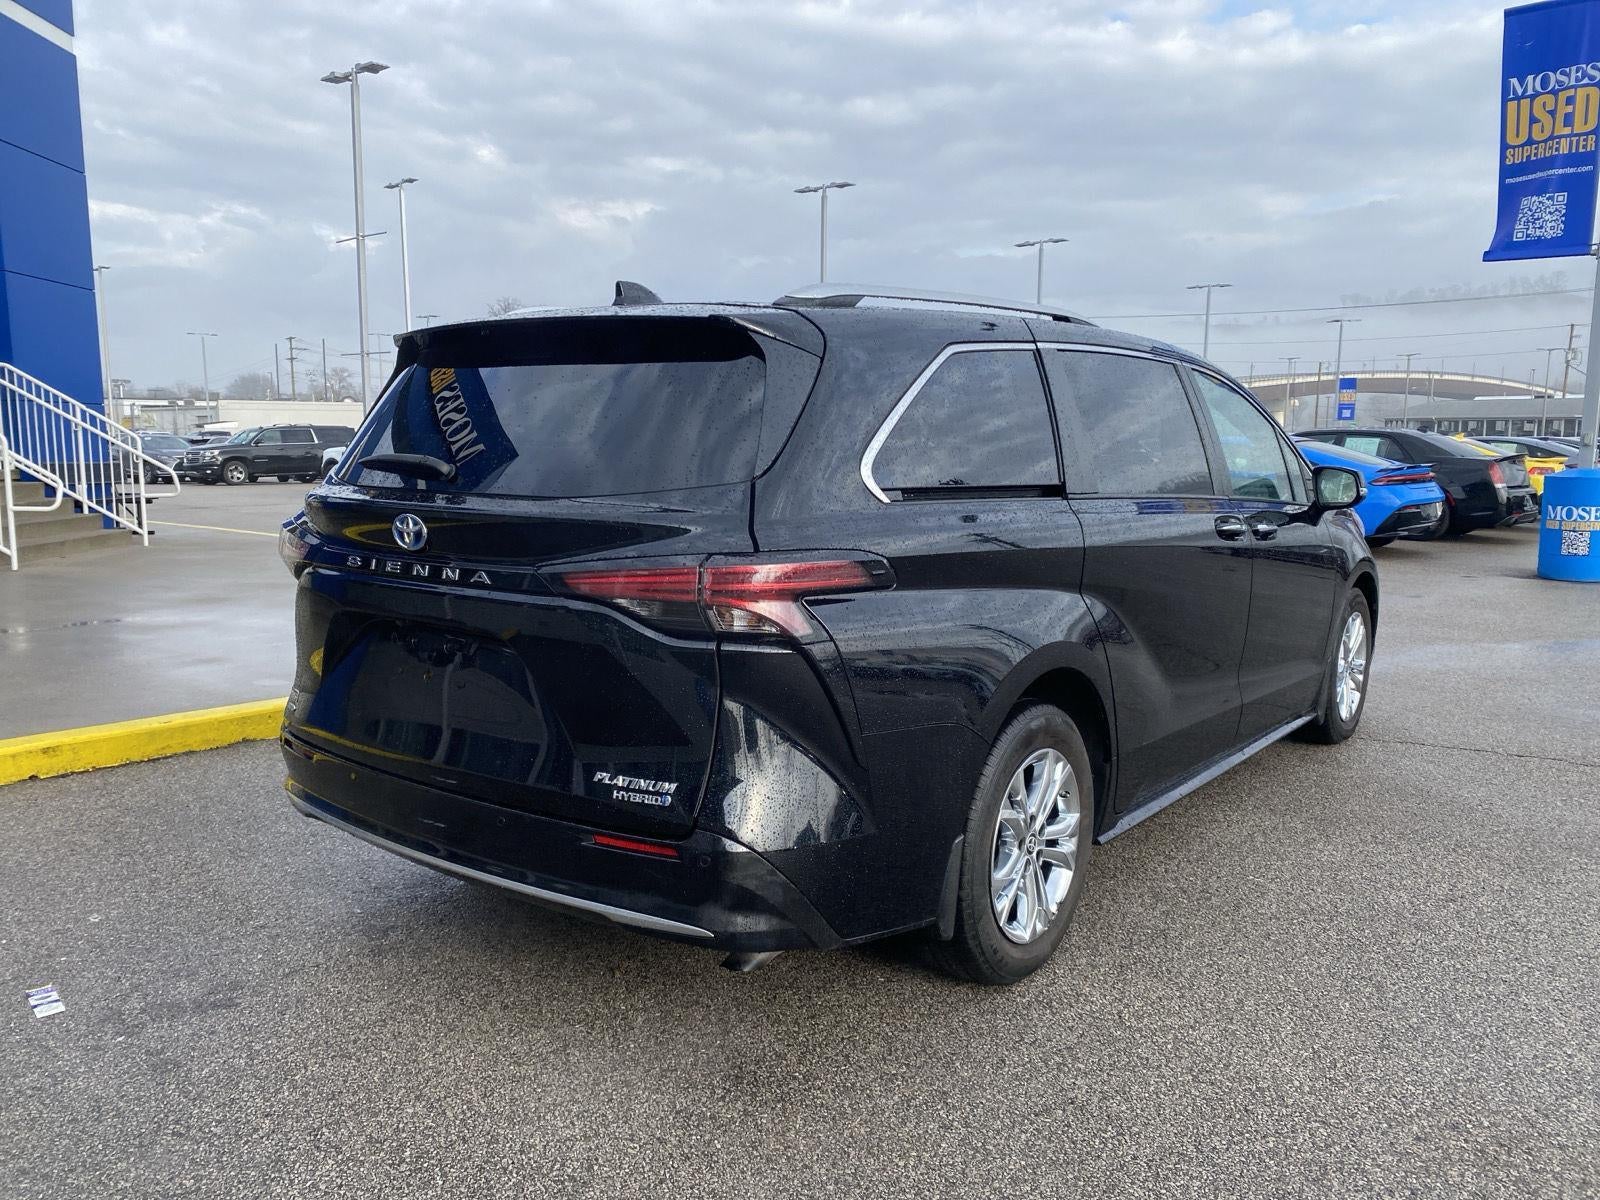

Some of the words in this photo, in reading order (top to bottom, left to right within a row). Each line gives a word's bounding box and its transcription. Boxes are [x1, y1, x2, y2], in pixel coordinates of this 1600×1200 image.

[1507, 62, 1600, 99] MOSES
[1506, 86, 1600, 146] USED
[1505, 134, 1597, 165] SUPERCENTER
[1505, 165, 1594, 184] mosesusedsupercenter.com
[346, 555, 493, 585] SIENNA
[592, 771, 679, 794] PLATINUM
[612, 789, 663, 806] HYBRID
